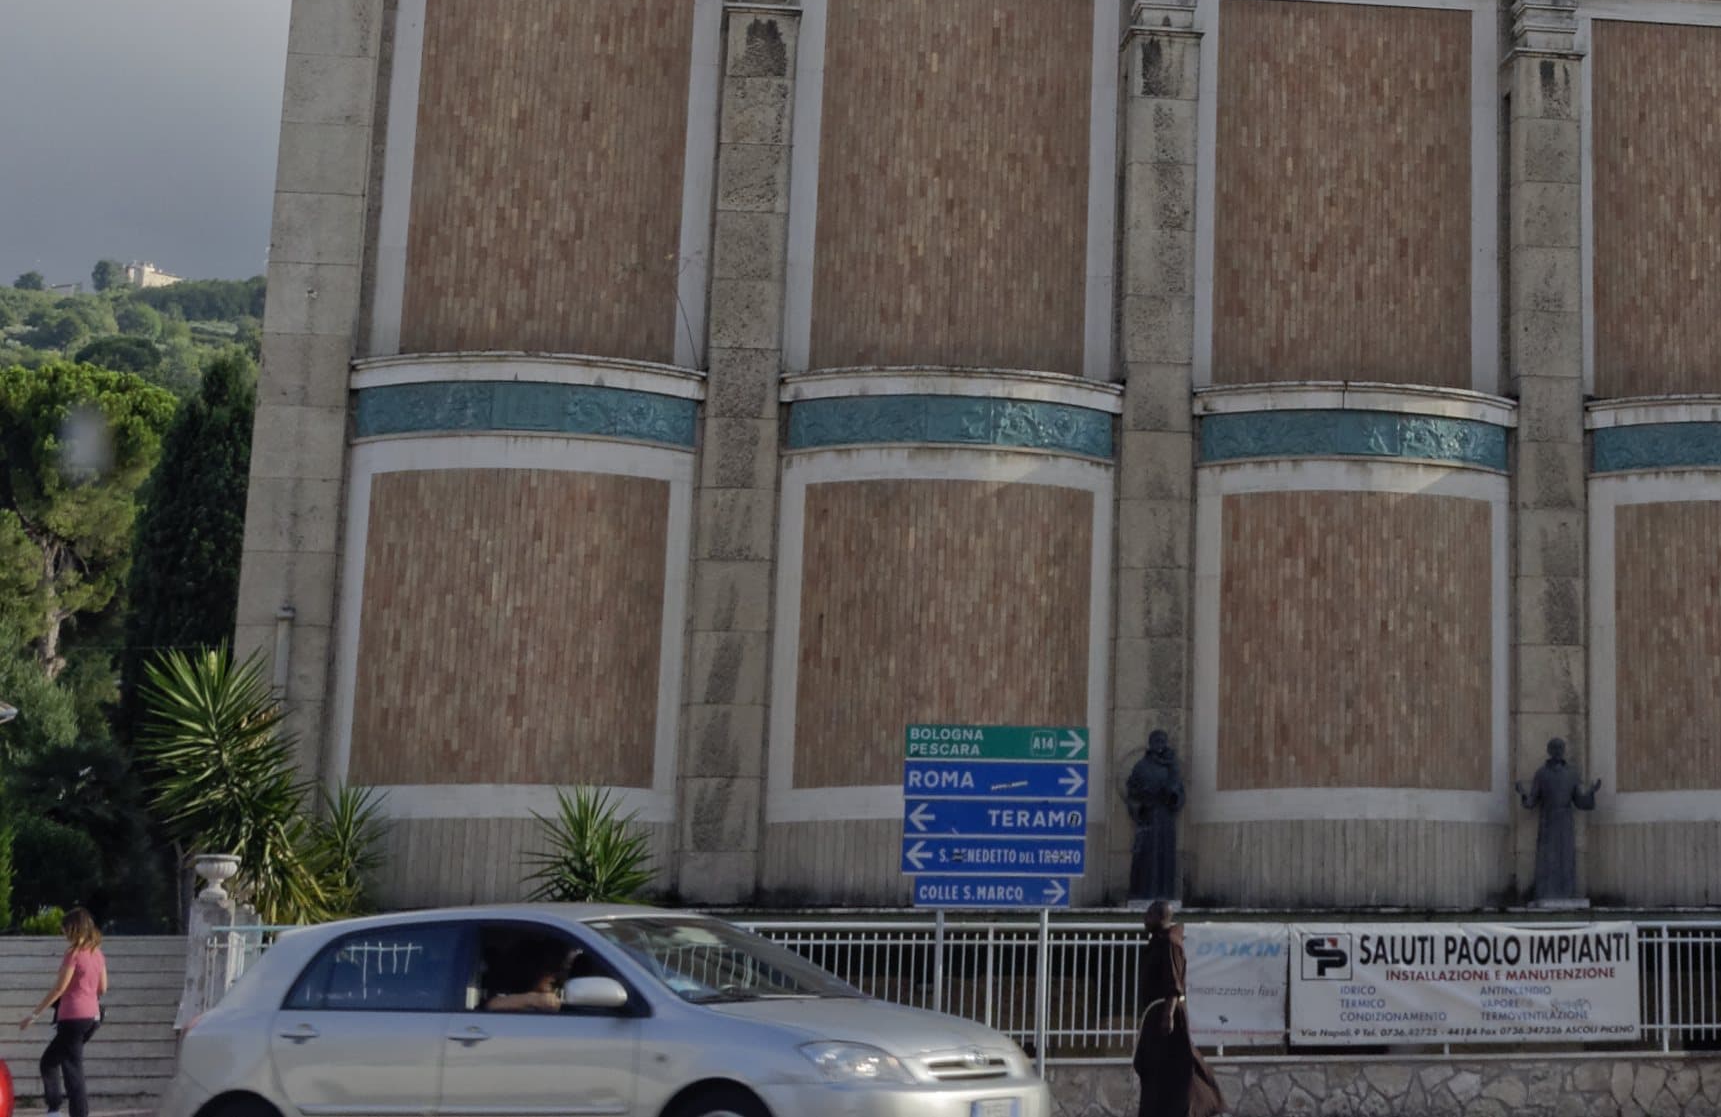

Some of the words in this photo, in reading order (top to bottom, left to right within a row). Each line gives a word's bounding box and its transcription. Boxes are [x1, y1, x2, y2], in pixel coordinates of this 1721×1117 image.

[910, 727, 984, 741] BOLOGNA
[910, 743, 981, 756] PESCARA
[1033, 738, 1054, 749] A14
[908, 770, 975, 789] ROMA
[939, 848, 949, 863] S.
[1019, 852, 1035, 864] DEL
[919, 885, 959, 901] COLLE
[1196, 940, 1281, 957] DAIKIN
[1359, 935, 1435, 966] SALUTI
[1444, 935, 1521, 966] PAOLO
[1529, 932, 1630, 965] IMPIANTI
[1385, 969, 1489, 982] INSTALLAZIONE
[1495, 970, 1501, 981] E
[1505, 967, 1616, 981] MANUTENZIONE
[1340, 985, 1376, 996] IDRICO
[1480, 985, 1552, 996] ANTINCENDIO
[1340, 999, 1386, 1009] TERMICO
[1339, 1011, 1447, 1022] CONDIZIONAMENTO
[1481, 1011, 1588, 1022] TERMOVENTILAZIONE
[1301, 1029, 1318, 1037] Via
[1566, 1025, 1598, 1034] ASCOLI
[1600, 1024, 1634, 1033] PICENO
